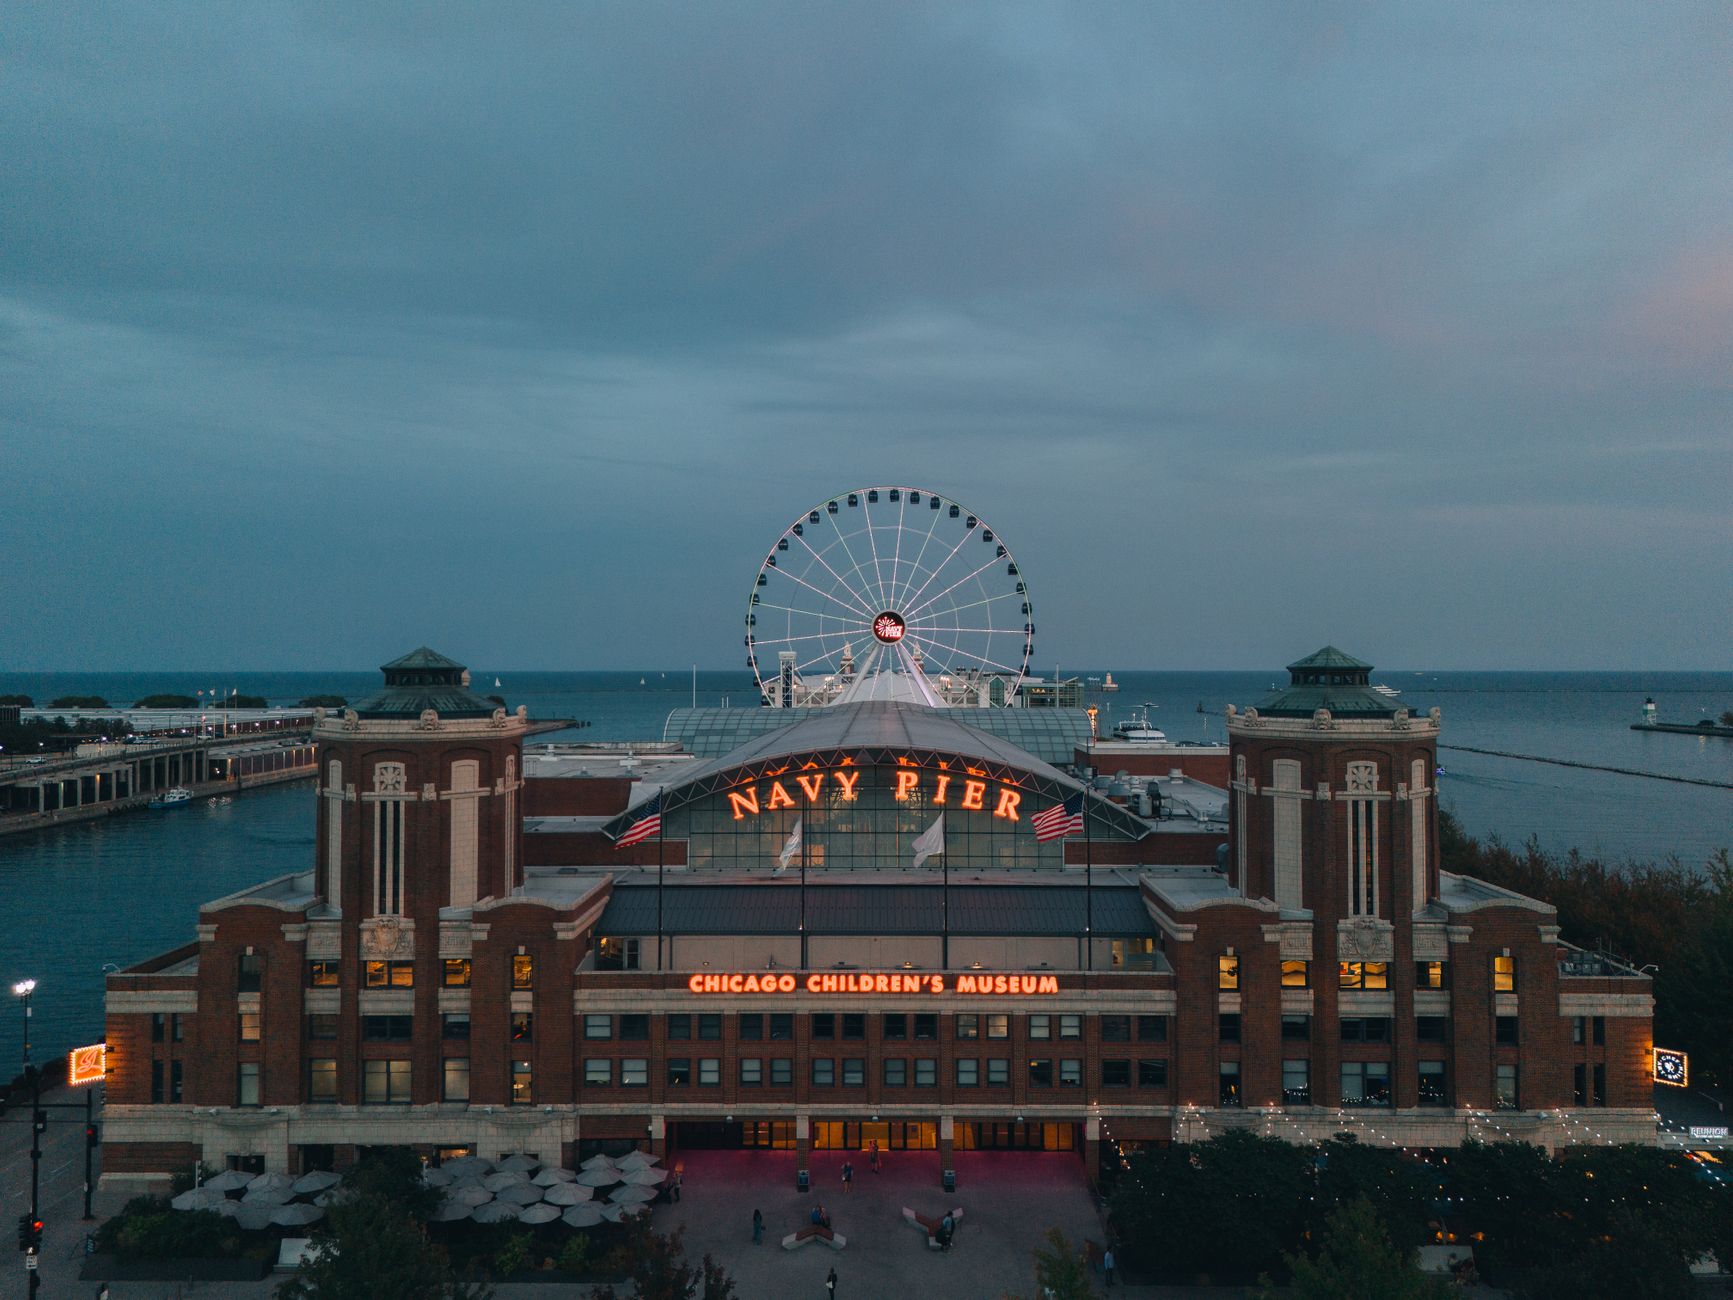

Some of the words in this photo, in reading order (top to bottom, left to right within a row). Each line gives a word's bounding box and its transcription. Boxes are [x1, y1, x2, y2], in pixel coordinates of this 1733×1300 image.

[728, 771, 859, 820] NAVY
[895, 771, 1021, 821] PIER
[689, 974, 796, 993] CHICAGO
[806, 974, 944, 993] CHILDREN'S
[956, 974, 1059, 994] MUSEUM
[1691, 1127, 1728, 1136] REUNION
